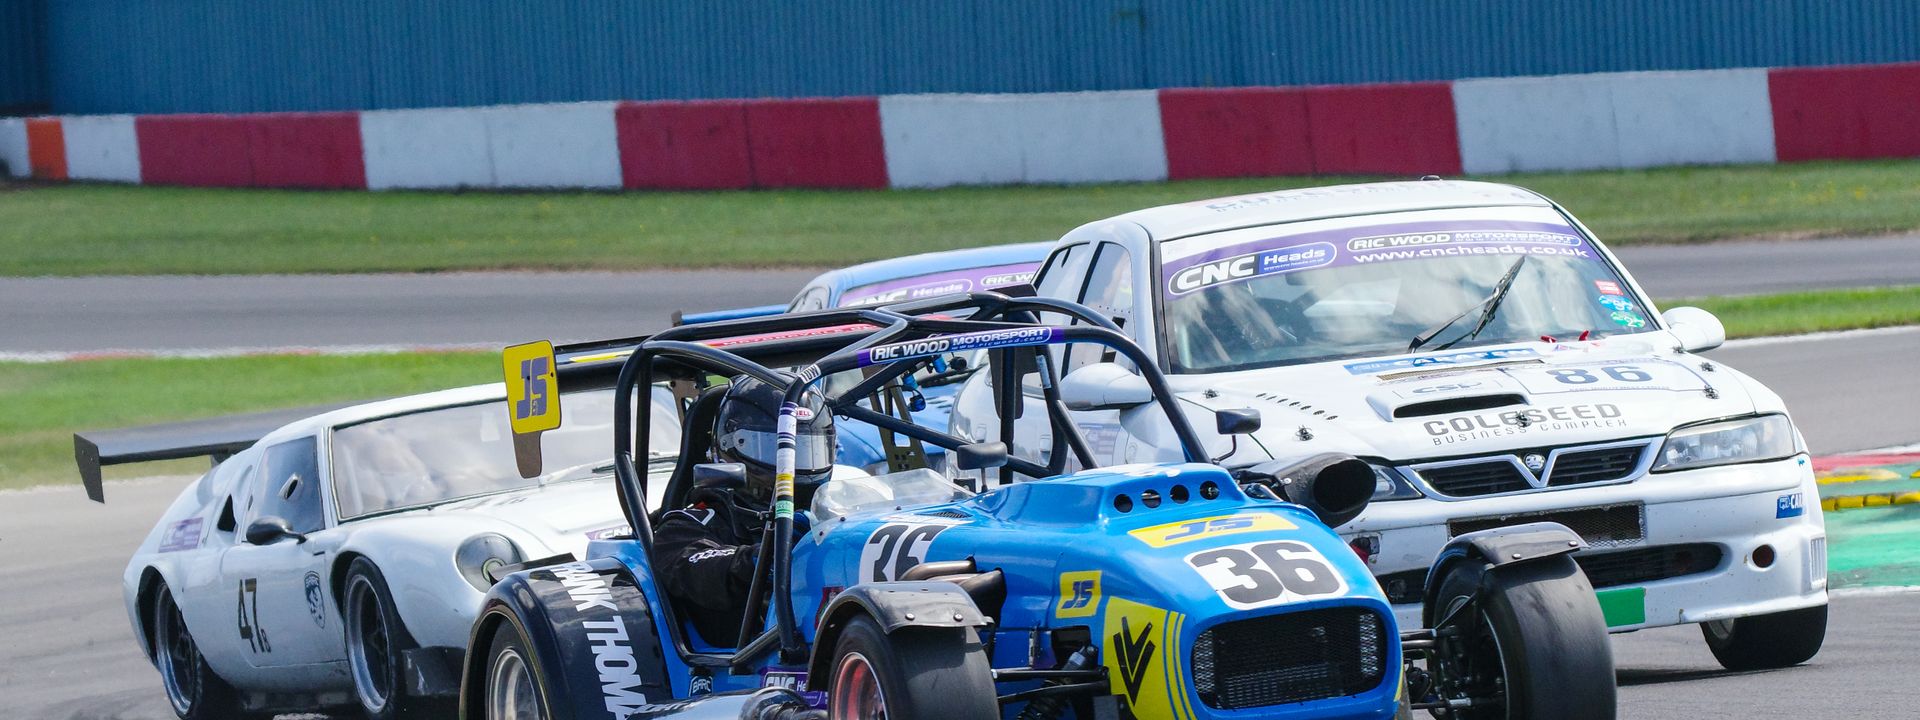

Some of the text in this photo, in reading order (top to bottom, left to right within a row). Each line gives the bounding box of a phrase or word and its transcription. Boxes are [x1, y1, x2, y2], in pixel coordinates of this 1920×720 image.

[1353, 232, 1576, 250] RIC WOOD MOTORSPORT
[1353, 243, 1589, 263] www.cncheads.co.uk
[985, 275, 1014, 286] RIC
[1176, 249, 1326, 290] CNC Heads
[912, 283, 964, 298] Heads
[873, 328, 1047, 361] RIC WOOD MOTORSPORT
[1546, 365, 1654, 385] 86
[516, 356, 549, 420] JS
[1423, 403, 1623, 437] COLESEED
[1433, 426, 1528, 447] BUSINESS
[1164, 516, 1254, 541] JS
[869, 525, 948, 582] 36
[1190, 542, 1340, 604] 36
[1061, 579, 1095, 609] JS
[692, 680, 712, 694] BARC
